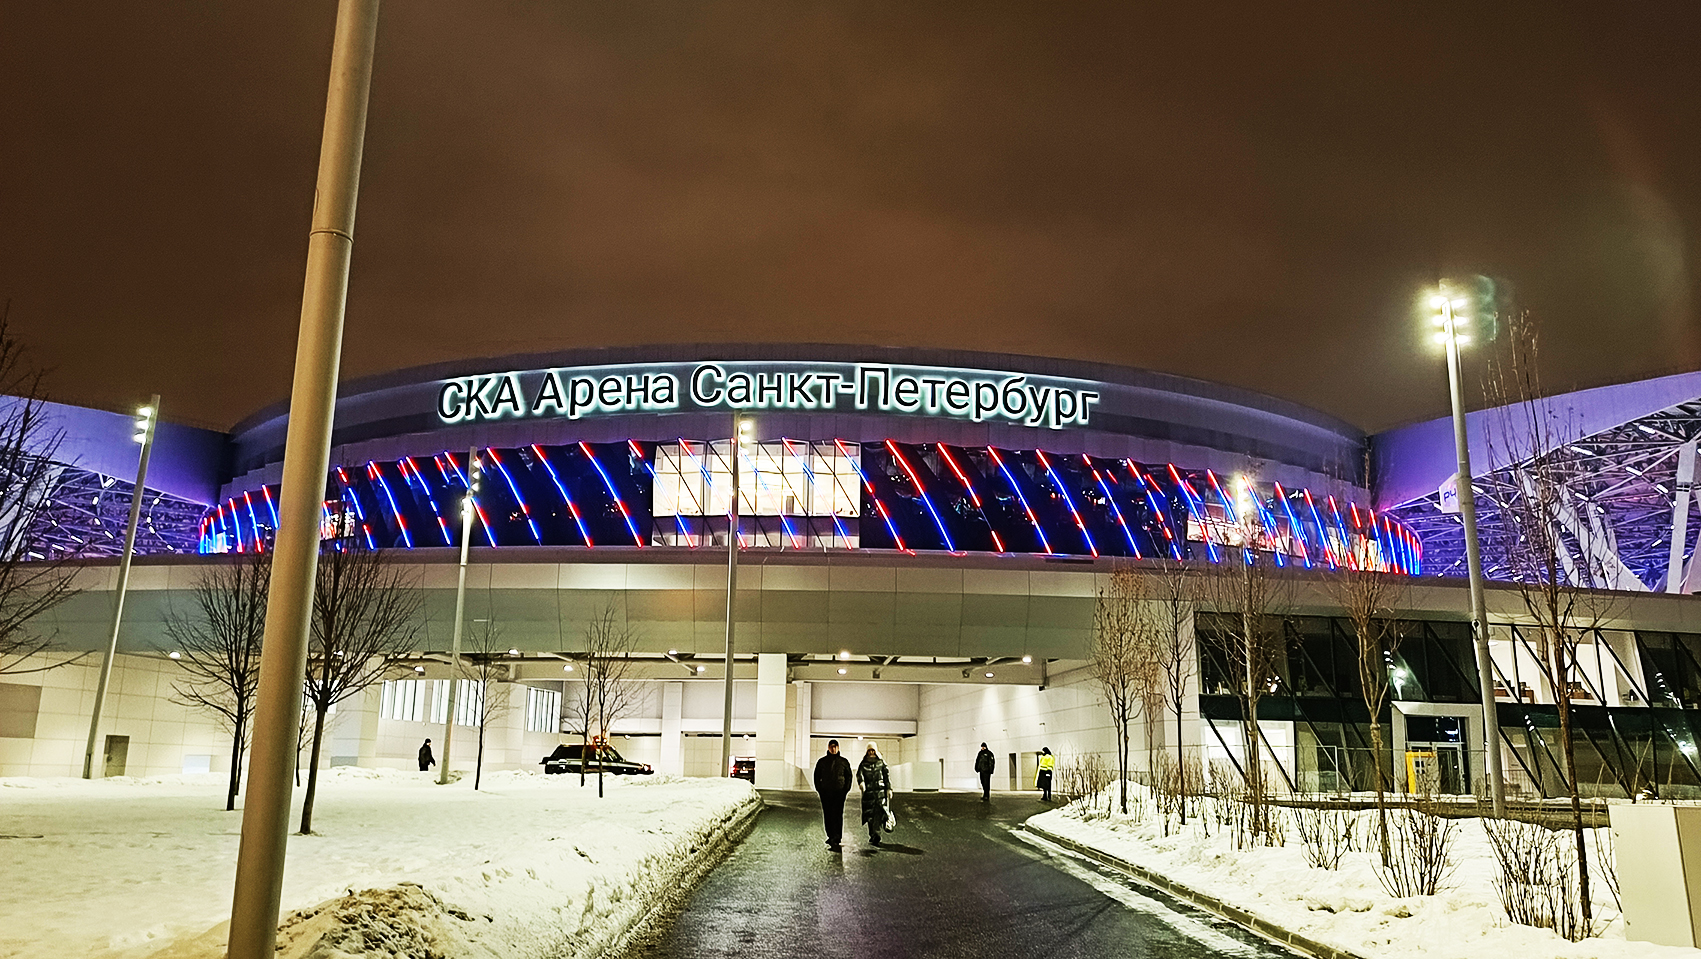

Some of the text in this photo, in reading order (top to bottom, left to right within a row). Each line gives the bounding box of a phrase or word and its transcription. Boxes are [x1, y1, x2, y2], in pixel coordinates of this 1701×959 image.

[438, 364, 1100, 427] СКА Арена Санкт-Петербург
